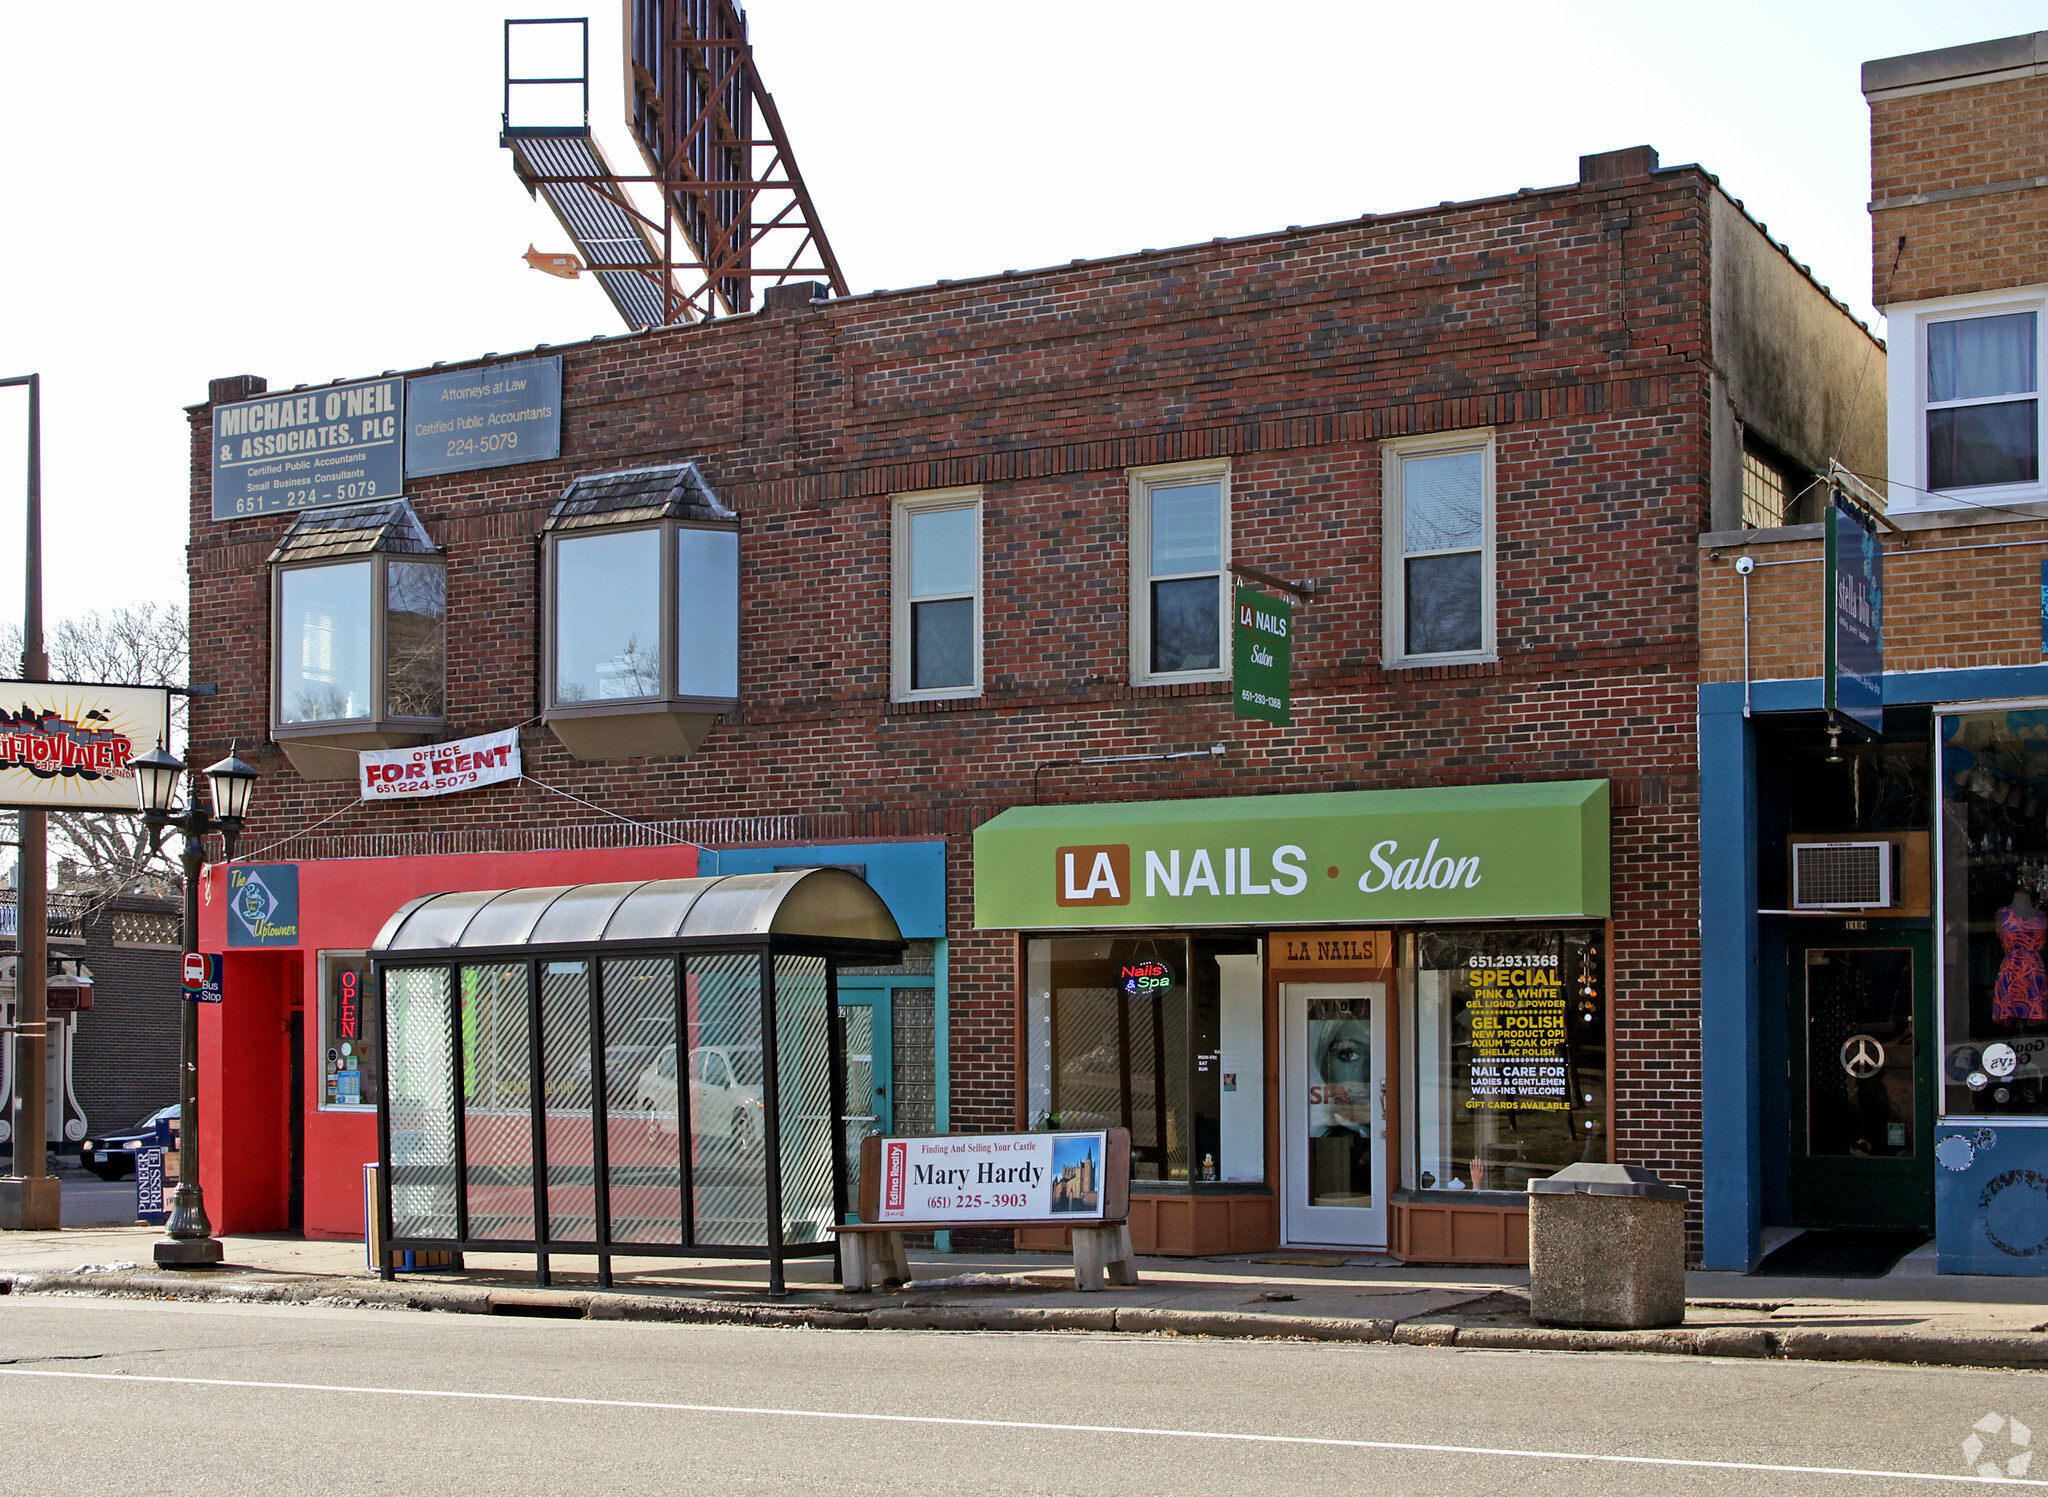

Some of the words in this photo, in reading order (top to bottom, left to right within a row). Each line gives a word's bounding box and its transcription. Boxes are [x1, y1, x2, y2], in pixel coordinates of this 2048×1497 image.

[441, 385, 490, 402] Attorneys
[492, 381, 503, 393] at
[506, 379, 527, 392] Law
[220, 396, 319, 437] MICHAEL
[325, 383, 395, 421] O'NEIL
[415, 419, 454, 436] Certified
[457, 415, 484, 430] Public
[487, 406, 552, 426] Accountants
[220, 444, 233, 461] &
[241, 423, 354, 460] ASSOCIATES,
[362, 416, 395, 441] PLC
[446, 431, 518, 457] 224-5079
[248, 462, 282, 477] Certified
[285, 458, 311, 472] Public
[314, 452, 367, 468] Accountants
[247, 478, 270, 493] Small
[273, 474, 311, 489] Business
[314, 468, 365, 483] Consultants
[236, 495, 264, 513] 651
[287, 489, 317, 506] 224
[337, 480, 376, 499] 5079
[1240, 605, 1252, 627] LA
[1256, 611, 1287, 637] NAILS
[1251, 644, 1273, 668] Salon
[1242, 689, 1282, 709] 651-293-1368
[413, 745, 462, 762] OFFICE
[365, 762, 426, 788] FOR
[431, 744, 512, 776] RENT
[376, 784, 397, 794] 651
[231, 869, 247, 888] The
[1064, 851, 1121, 899] LA
[1145, 844, 1308, 897] NAILS
[1358, 838, 1482, 893] Salon
[254, 918, 297, 943] Uptowner
[1287, 941, 1311, 961] LA
[1317, 940, 1373, 961] NAILS
[1121, 964, 1163, 978] Nails
[1468, 955, 1559, 968] 651.293.1368
[202, 980, 219, 990] Bus
[1127, 979, 1135, 989] &
[1137, 976, 1170, 990] Spa
[1469, 969, 1562, 987] SPECIAL
[202, 991, 222, 1003] Stop
[1475, 989, 1503, 999] PINK
[1505, 989, 1514, 998] &
[1516, 988, 1557, 998] WHITE
[341, 971, 356, 1038] OPEN
[1465, 1000, 1482, 1009] GEL
[1485, 1000, 1516, 1009] LIQUID
[1517, 1000, 1524, 1009] &
[1525, 1000, 1566, 1008] POWDER
[1471, 1017, 1502, 1029] GEL
[1506, 1016, 1564, 1029] POLISH
[1472, 1030, 1496, 1038] NEW
[1497, 1030, 1545, 1038] PRODUCT
[1547, 1030, 1564, 1038] OPI
[1472, 1039, 1503, 1047] AXIUM
[1479, 1048, 1521, 1057] SHELLAC
[1522, 1048, 1555, 1056] POLISH
[1471, 1066, 1500, 1077] NAIL
[1502, 1066, 1537, 1077] CARE
[1539, 1066, 1565, 1076] FOR
[1471, 1078, 1502, 1086] LADIES
[1503, 1078, 1510, 1086] &
[1511, 1078, 1565, 1086] GENTLEMEN
[1472, 1087, 1516, 1095] WALK-INS
[1518, 1087, 1565, 1095] WELCOME
[1310, 1085, 1350, 1105] SPA
[1465, 1101, 1485, 1109] GIFT
[1487, 1101, 1519, 1110] CARDS
[1520, 1102, 1570, 1110] AVAILABLE
[921, 1143, 948, 1155] Finding
[950, 1143, 966, 1153] And
[967, 1142, 992, 1155] Selling
[993, 1142, 1011, 1152] Your
[1013, 1141, 1036, 1152] Castle
[890, 1146, 903, 1177] Realty
[137, 1153, 150, 1213] PIONEER
[913, 1163, 970, 1190] Mary
[977, 1160, 1044, 1189] Hardy
[150, 1169, 162, 1213] PRESS
[889, 1177, 899, 1206] Edina
[927, 1195, 951, 1210] (651)
[956, 1194, 1027, 1208] 225-3903
